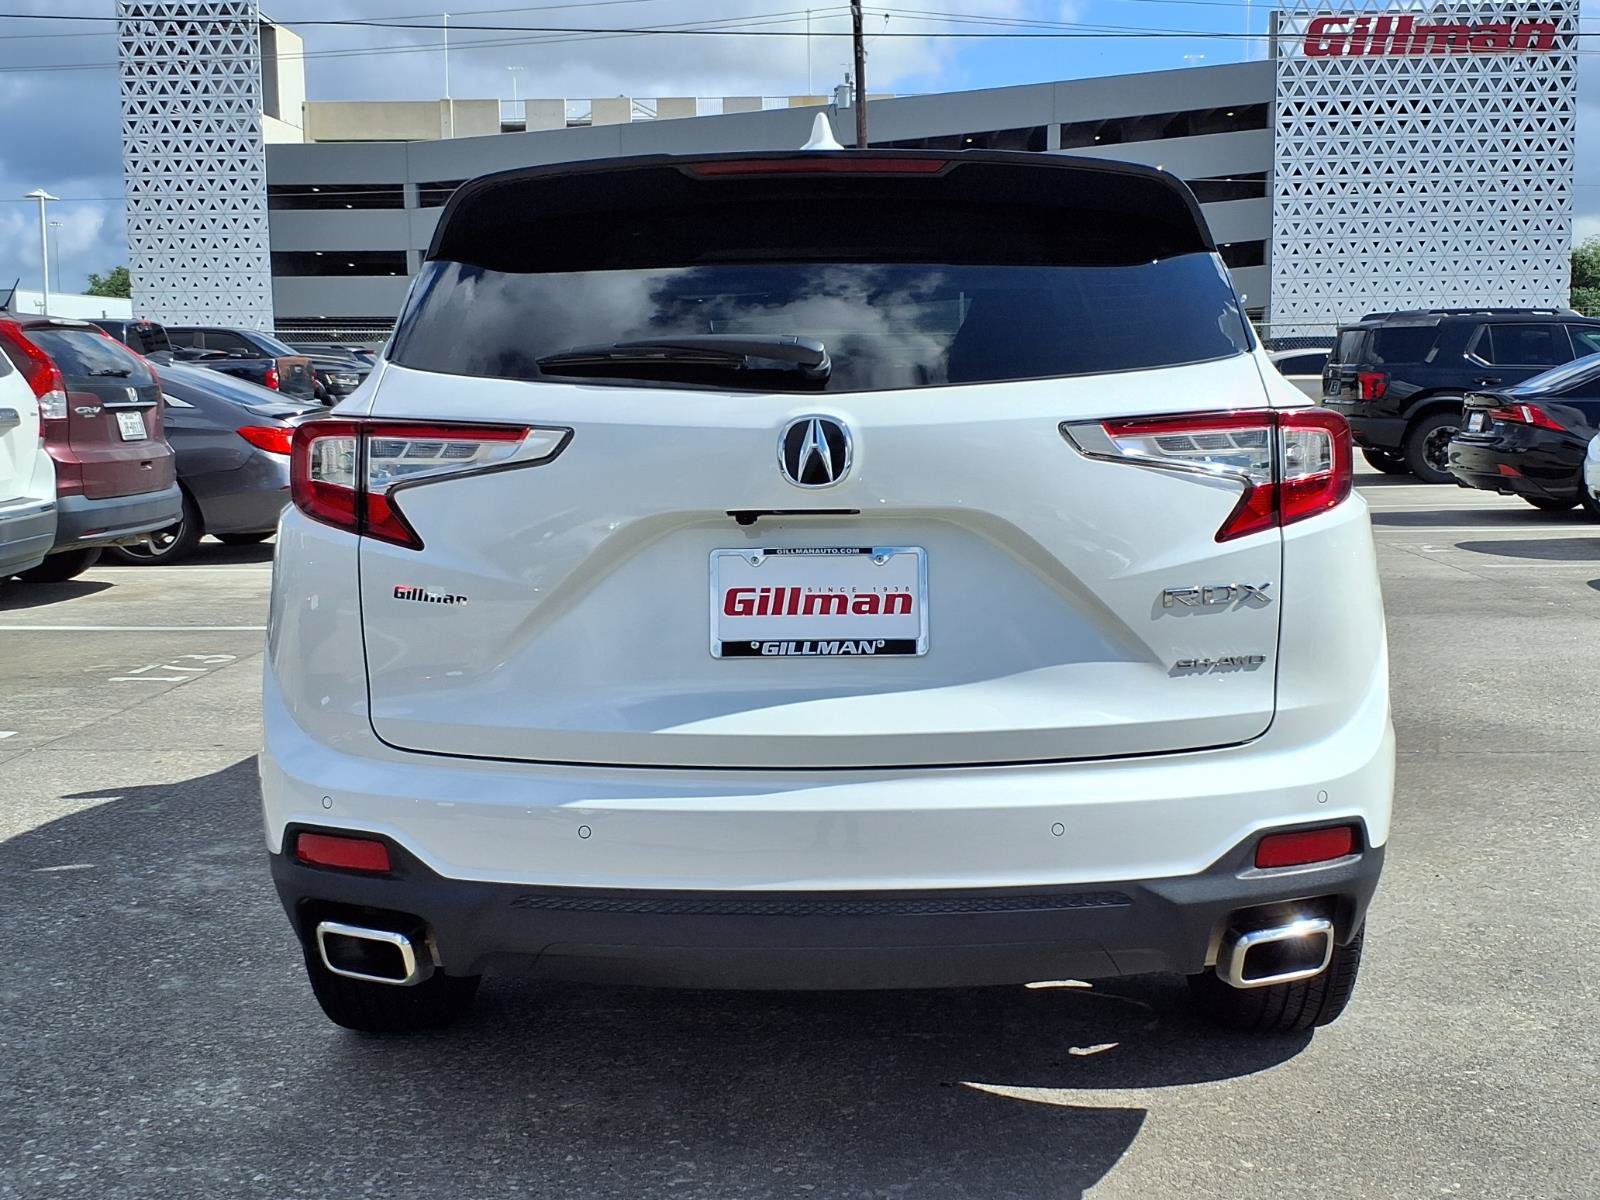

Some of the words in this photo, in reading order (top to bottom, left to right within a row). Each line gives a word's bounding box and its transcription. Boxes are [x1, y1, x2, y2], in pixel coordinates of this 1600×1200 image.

[1303, 15, 1556, 56] Gillman
[776, 547, 860, 555] GILLMANAUTO.COM
[393, 585, 469, 606] Gillman
[723, 587, 913, 616] Gillman
[1163, 582, 1272, 608] RDX
[761, 641, 876, 656] GILLMAN
[1176, 655, 1266, 669] SH-AWD
